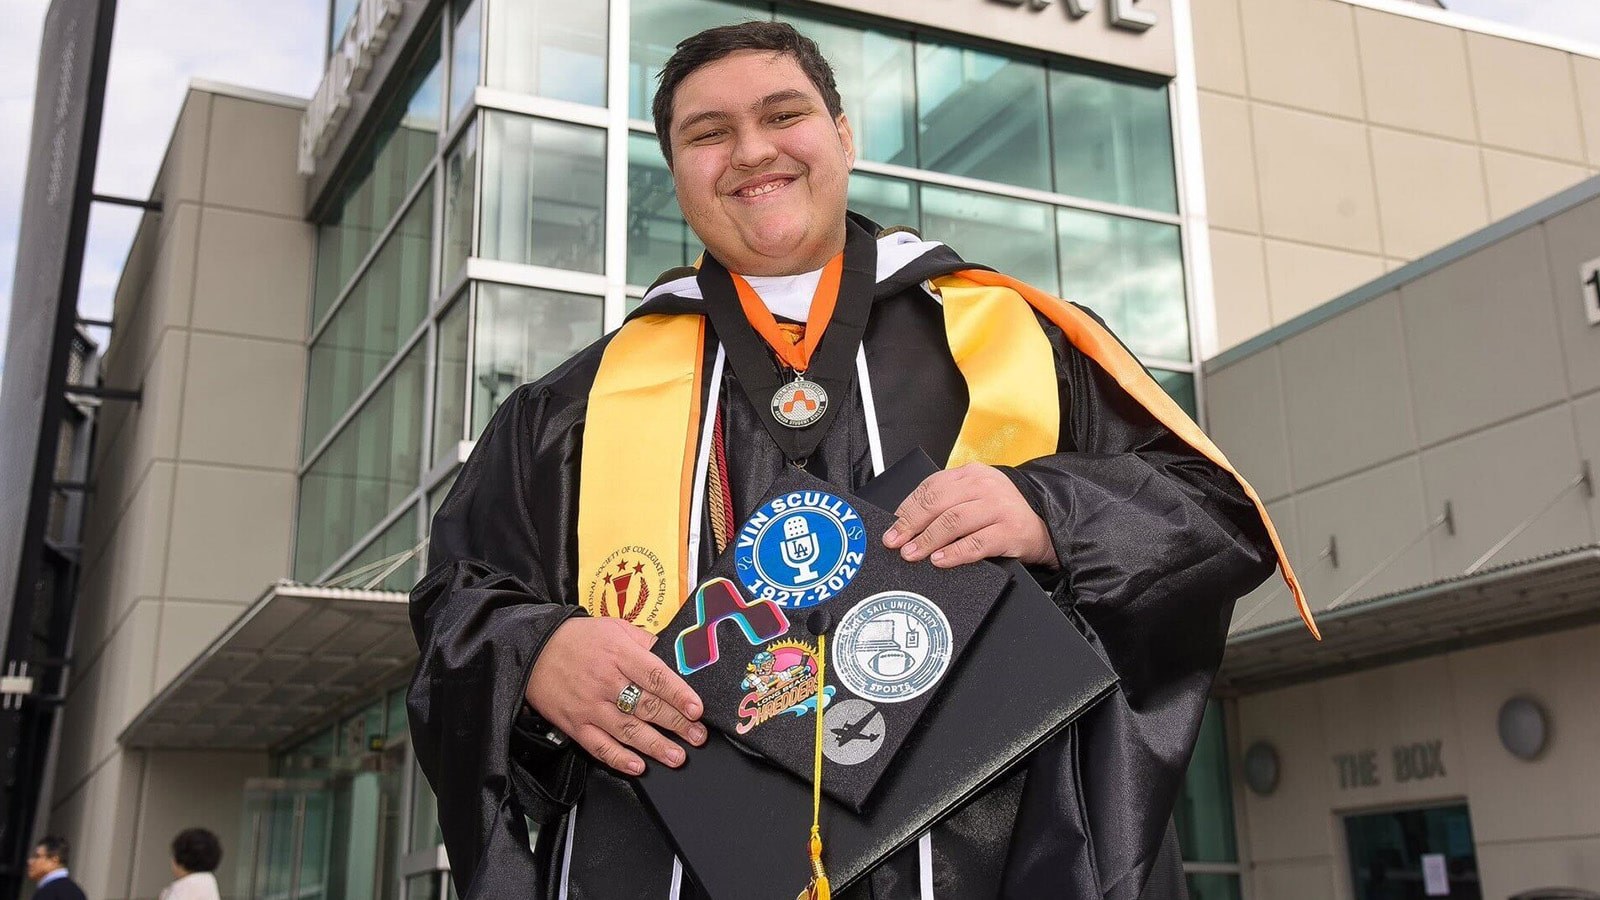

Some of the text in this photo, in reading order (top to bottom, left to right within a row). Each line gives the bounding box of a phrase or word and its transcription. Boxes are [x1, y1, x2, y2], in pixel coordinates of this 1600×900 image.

[737, 491, 858, 548] VIN SCULLY
[791, 540, 808, 559] LA
[588, 545, 667, 624] ATIONAL SOCIETY OF COLLEGIATE SCHOLARS
[747, 551, 864, 607] 1927-2022
[867, 603, 888, 616] SAIL
[890, 601, 939, 629] UNIVERSITY
[757, 673, 812, 707] LONG BEACH
[869, 682, 912, 694] SPORTS
[1332, 738, 1448, 789] THE BOX
